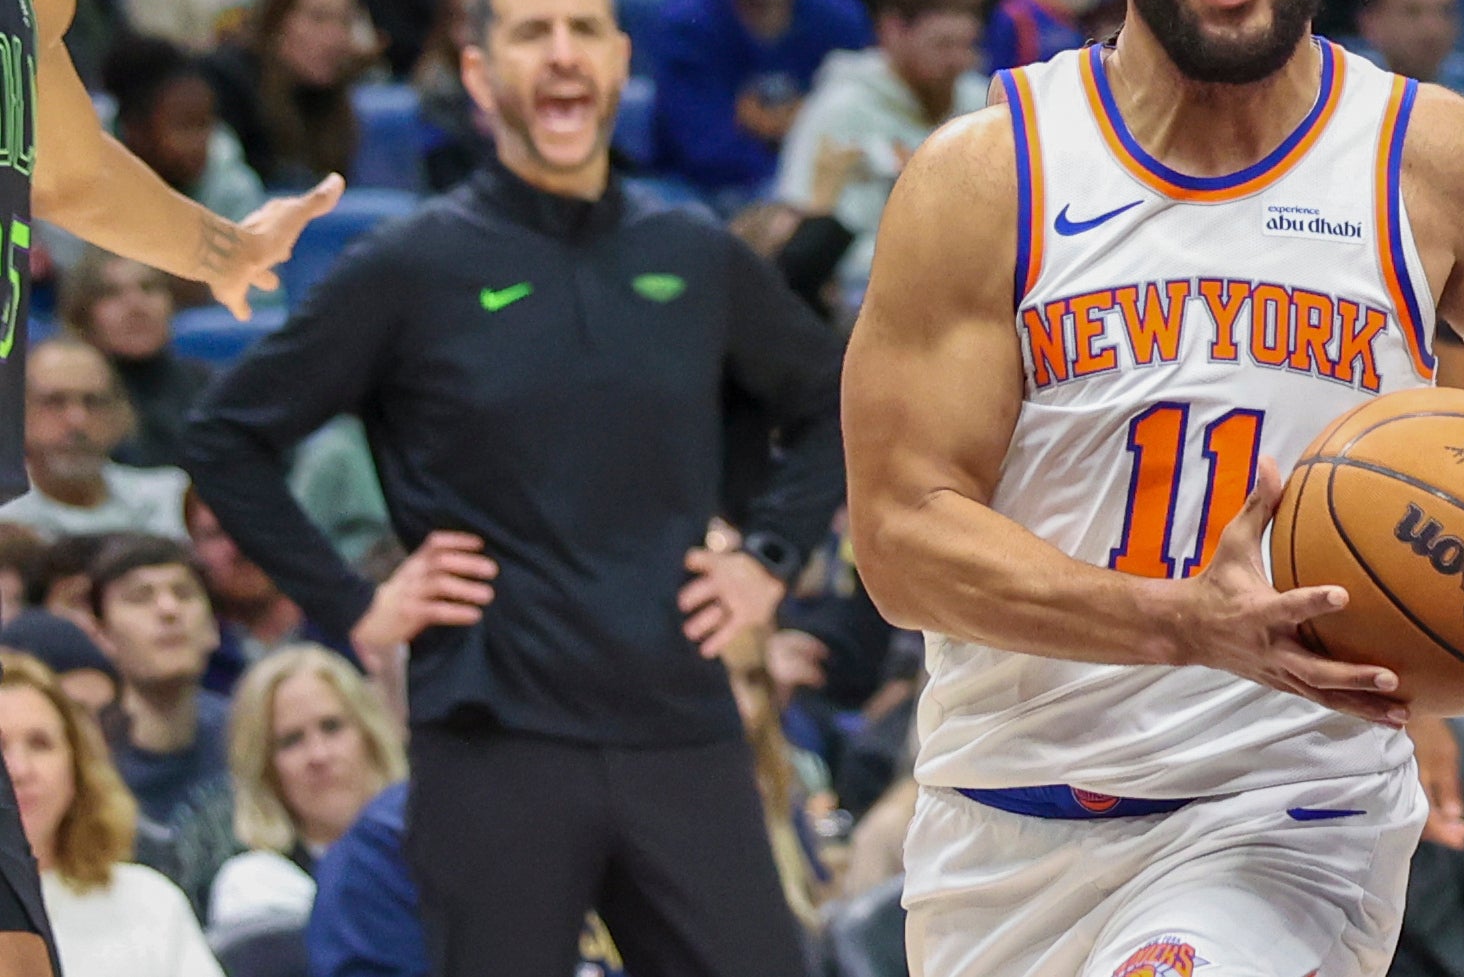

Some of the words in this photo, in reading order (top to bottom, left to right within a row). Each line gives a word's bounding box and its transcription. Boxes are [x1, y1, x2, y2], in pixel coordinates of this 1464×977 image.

[1266, 215, 1304, 231] abu
[1307, 217, 1362, 238] dhabi
[1267, 205, 1320, 215] experience
[1021, 278, 1192, 391] NEW
[1198, 277, 1390, 395] YORK
[1108, 400, 1266, 580] 11
